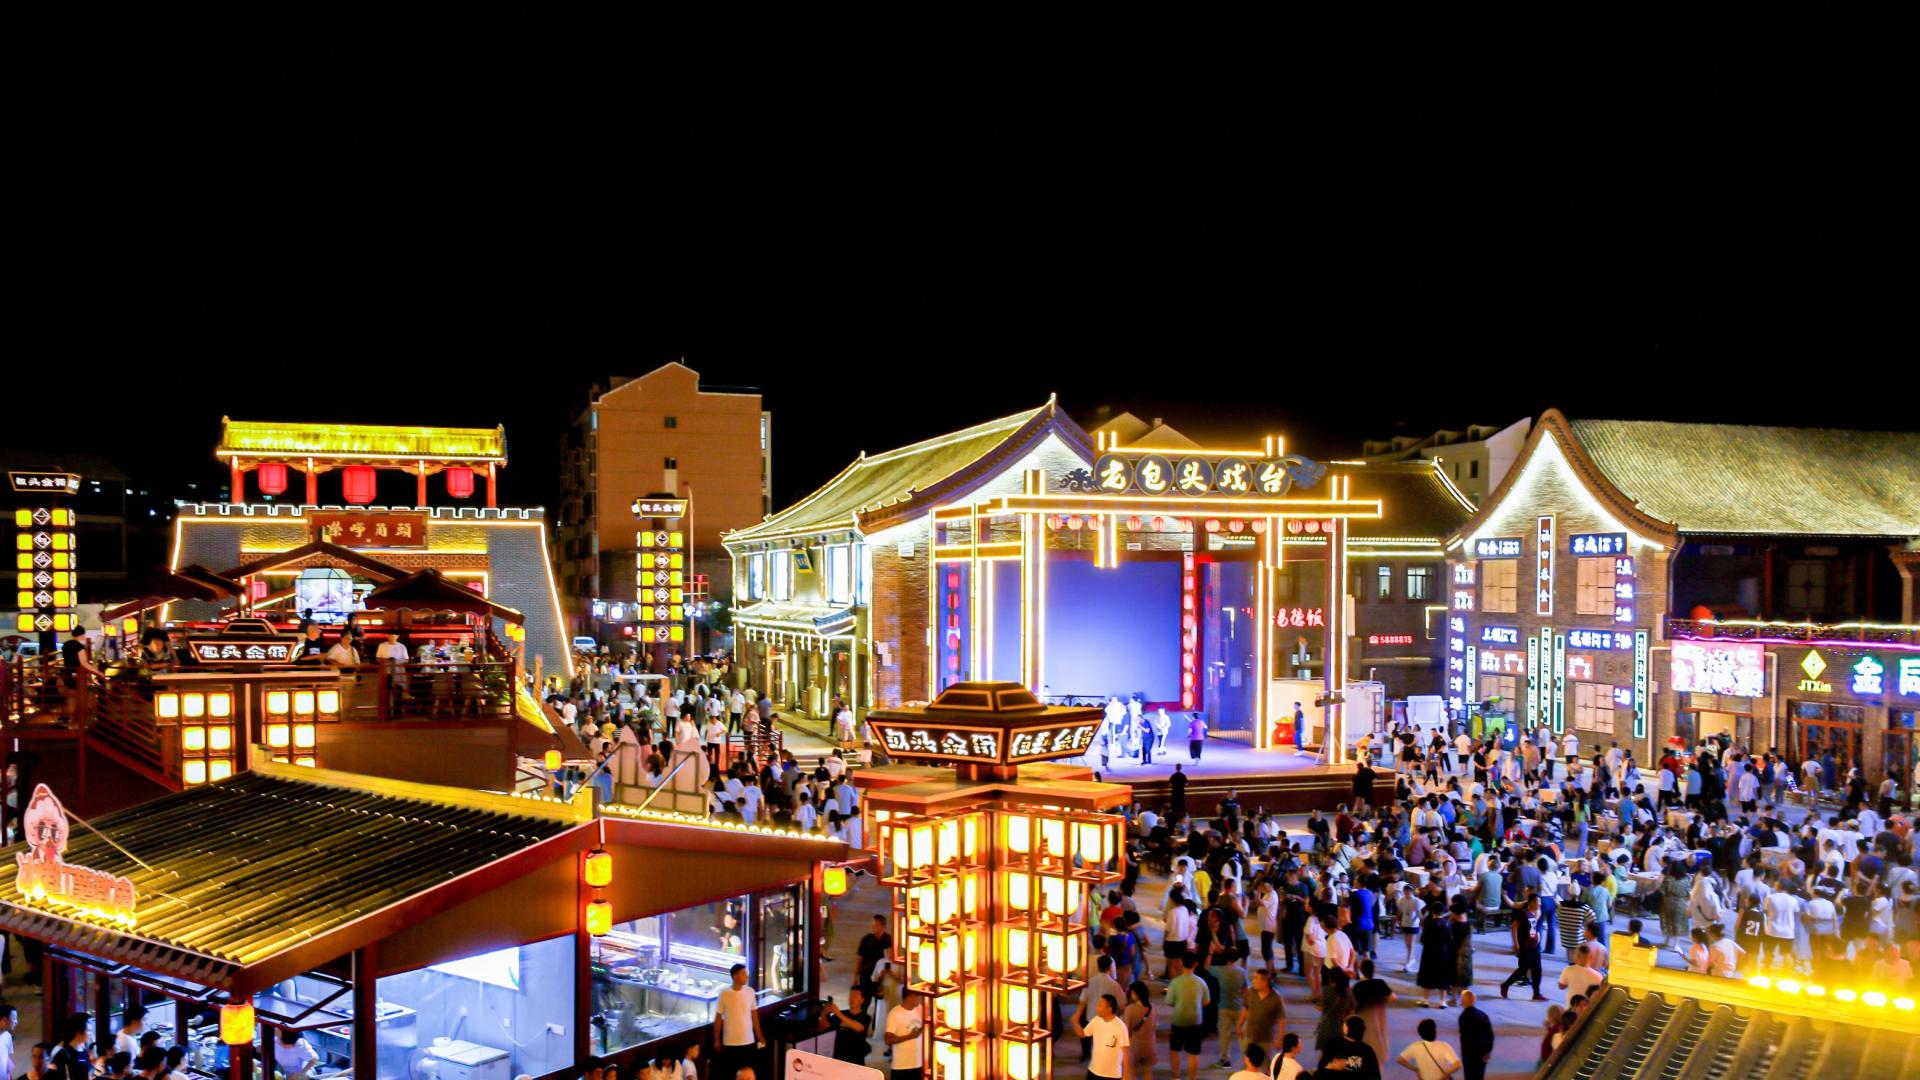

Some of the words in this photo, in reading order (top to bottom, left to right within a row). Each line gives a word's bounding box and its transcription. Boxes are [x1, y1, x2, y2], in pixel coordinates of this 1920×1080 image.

[1100, 459, 1286, 493] 老包头戏台
[199, 645, 288, 659] 包头金街
[884, 728, 997, 759] 包头金街
[1745, 920, 1760, 937] 21
